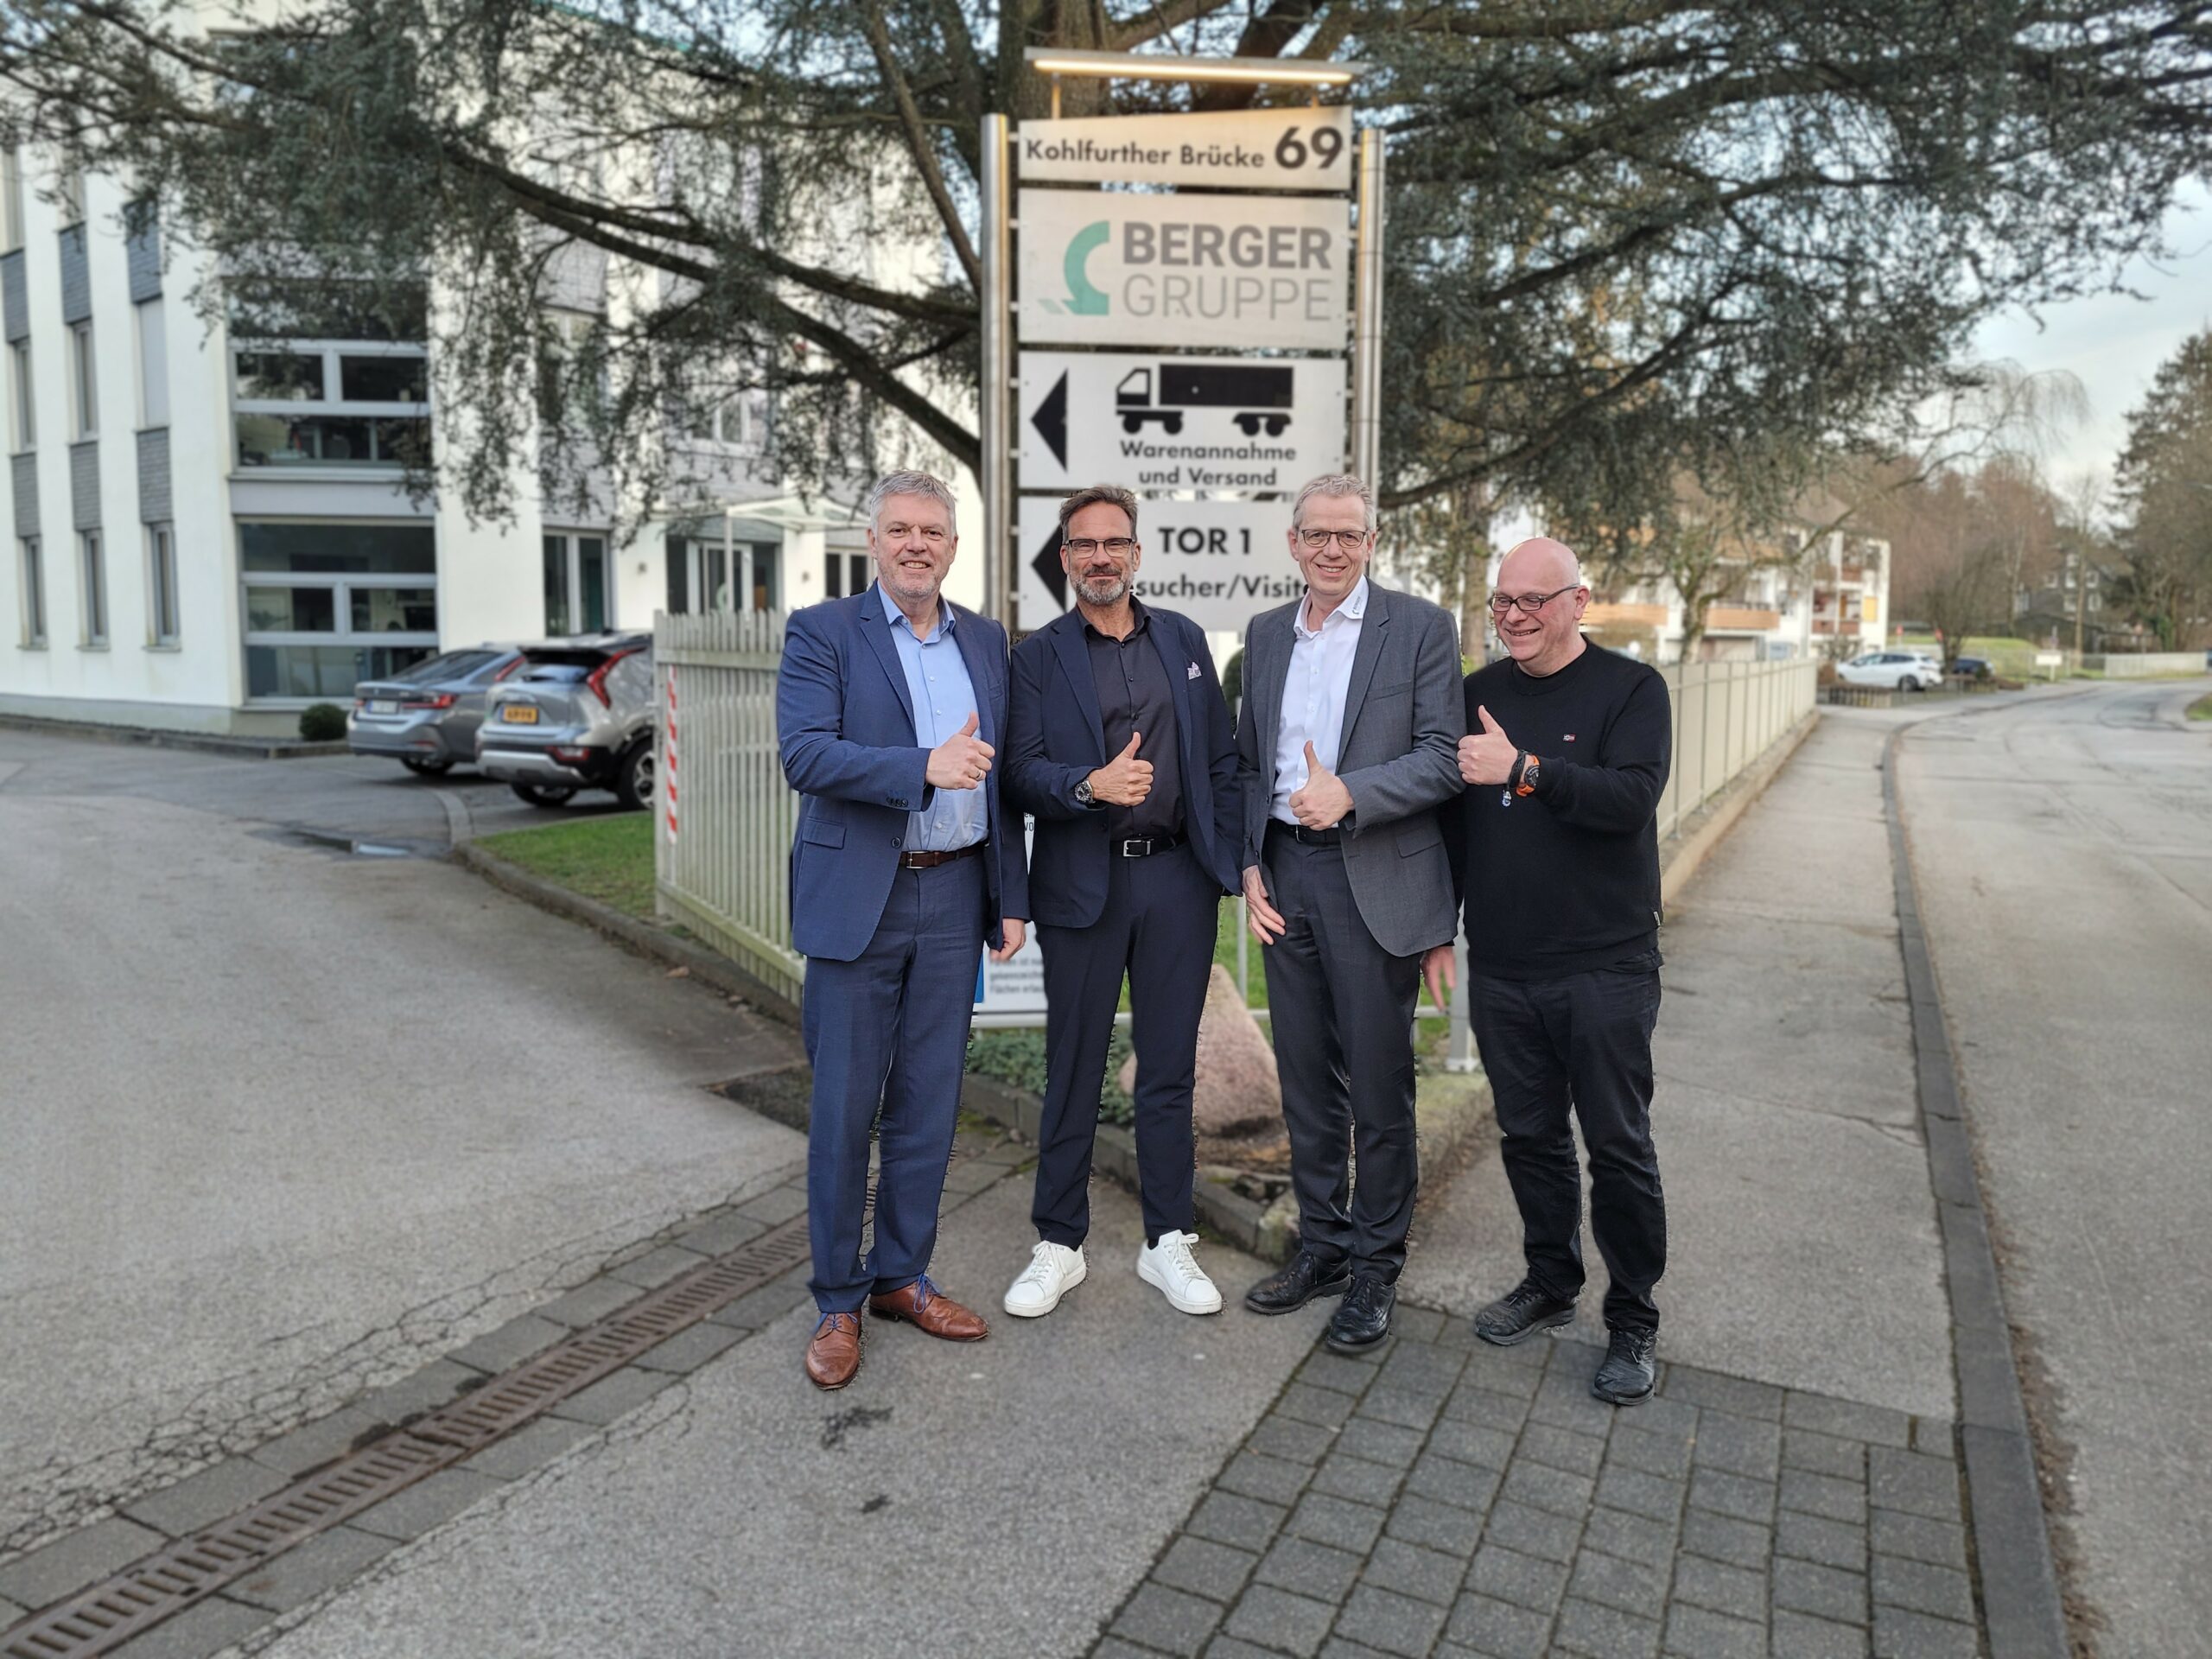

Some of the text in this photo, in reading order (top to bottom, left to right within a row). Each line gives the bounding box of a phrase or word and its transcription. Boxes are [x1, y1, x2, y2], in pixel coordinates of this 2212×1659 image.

[1026, 126, 1343, 169] Kohlfurther Brücke 69
[1123, 221, 1332, 270] BERGER
[1123, 273, 1332, 321] GRUPPE
[1120, 440, 1297, 461] Warenannahme
[1139, 466, 1277, 486] und Versand
[1158, 526, 1250, 555] TOR 1
[1130, 572, 1309, 600] sucher/Visit
